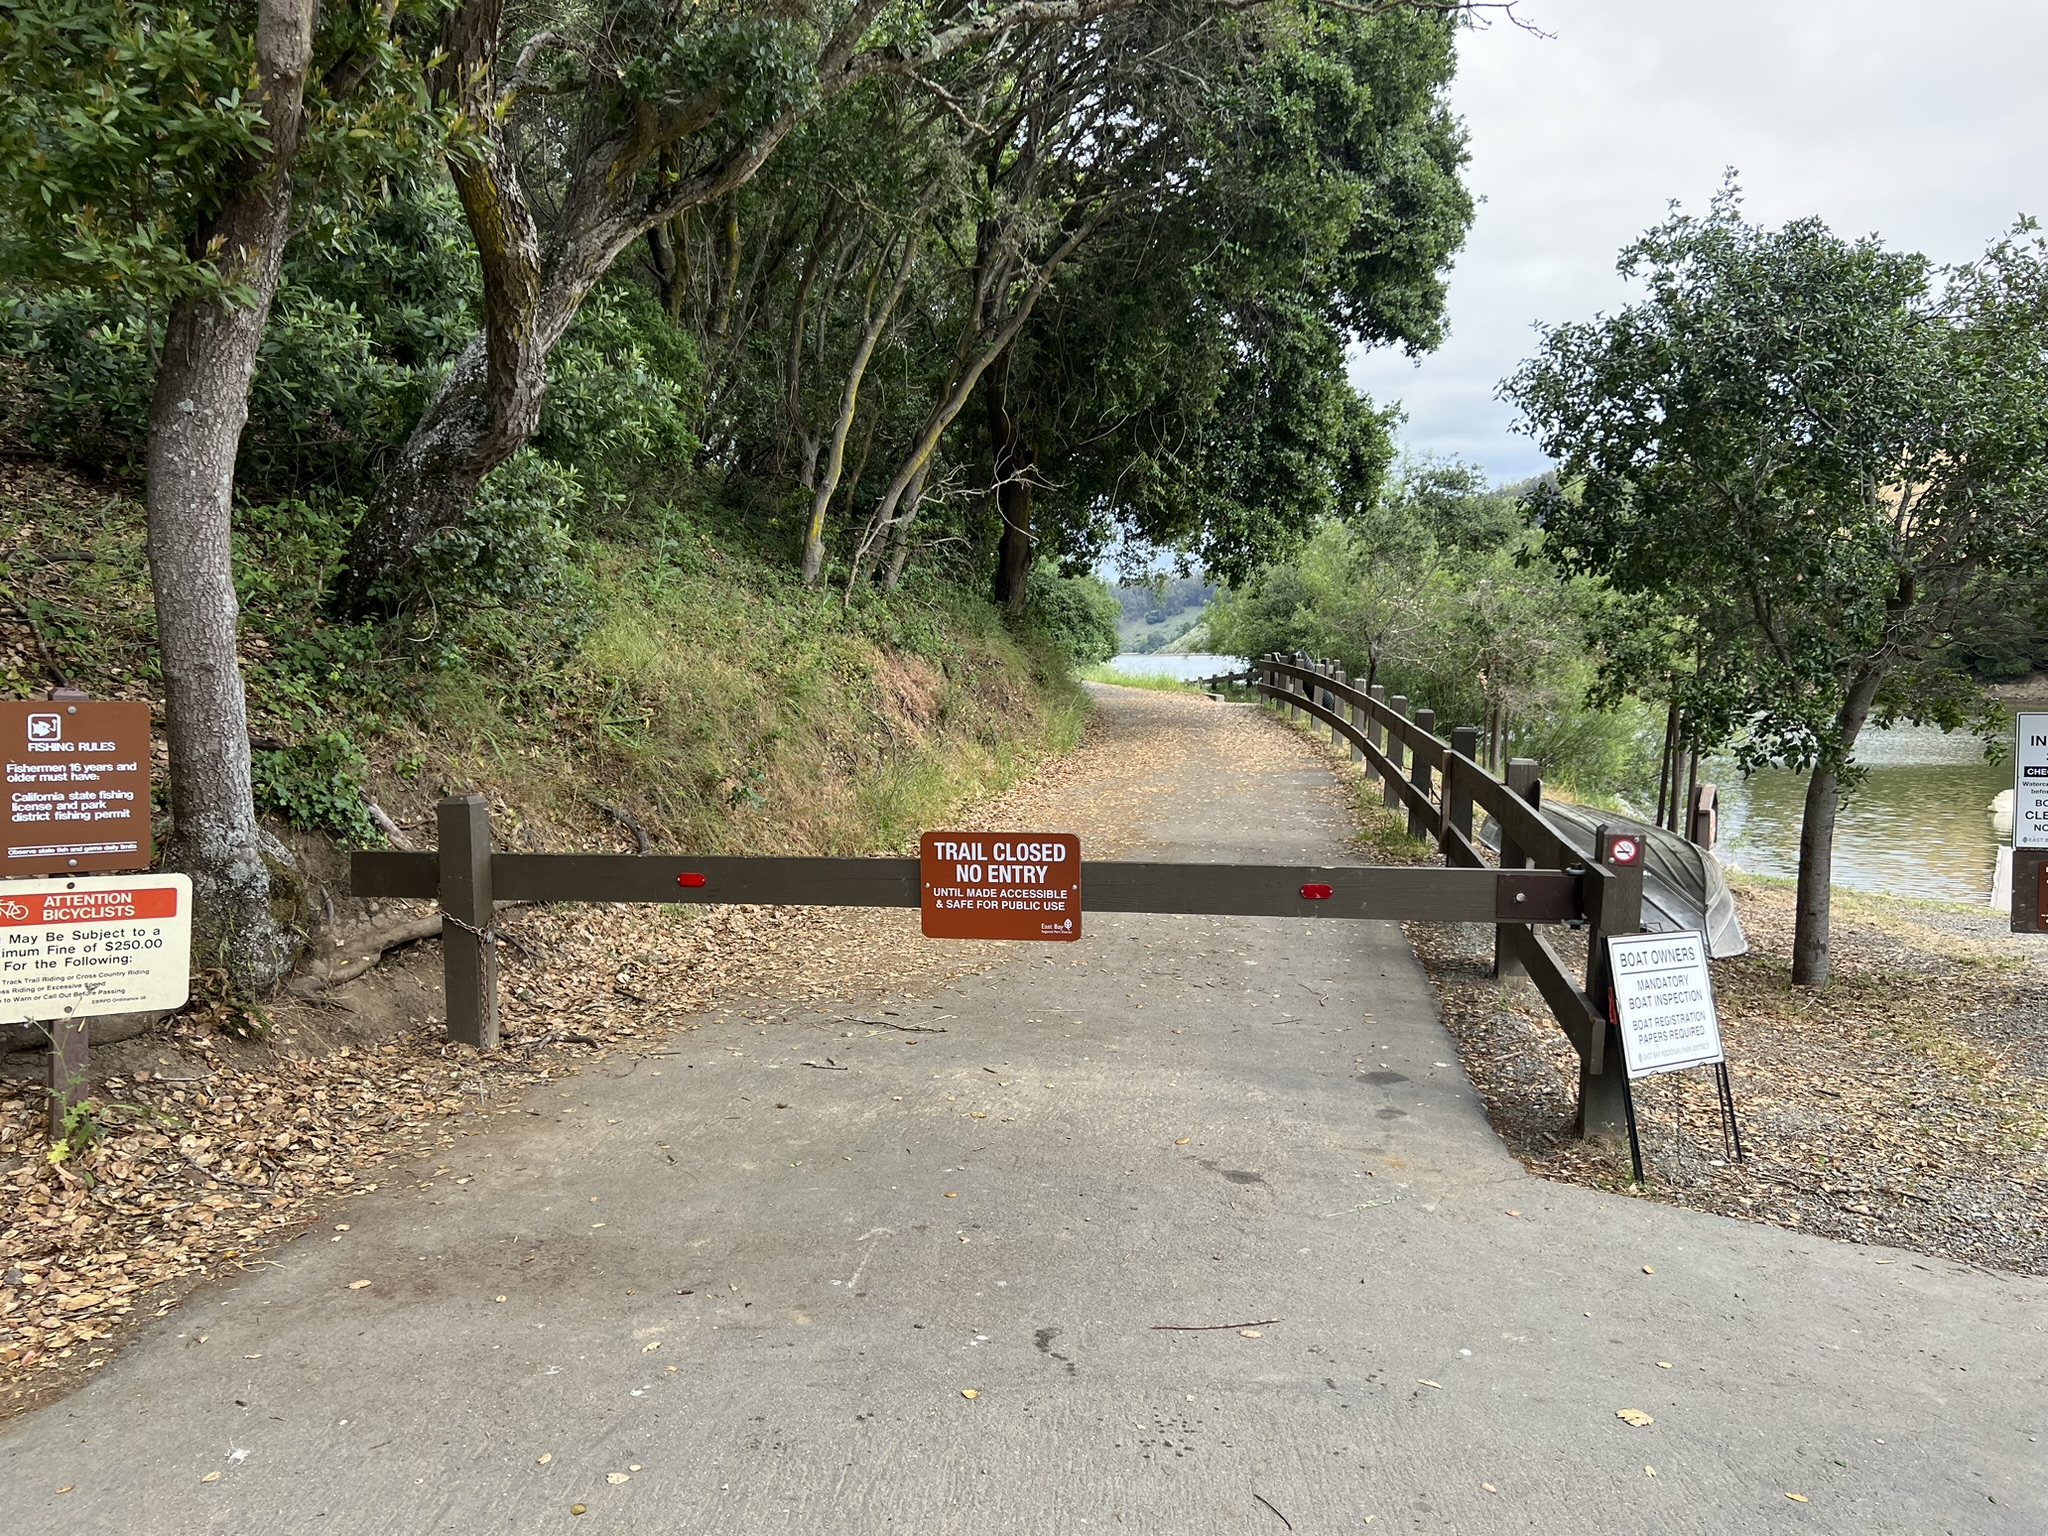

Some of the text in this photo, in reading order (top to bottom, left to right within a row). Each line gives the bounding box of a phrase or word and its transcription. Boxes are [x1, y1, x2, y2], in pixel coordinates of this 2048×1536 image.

[28, 742, 116, 752] FISHING RULES
[6, 762, 137, 774] Fishermen 16 years and
[7, 771, 100, 783] older must have:
[12, 790, 134, 803] California state fishing
[12, 801, 107, 812] license and park
[12, 809, 131, 822] district fishing permit
[934, 841, 1066, 862] TRAIL CLOSED
[956, 864, 1048, 884] NO ENTRY
[43, 893, 132, 908] ATTENTION
[933, 887, 1068, 900] UNTIL MADE ACCESSIBLE
[43, 905, 135, 921] BICYCLISTS
[936, 900, 1066, 911] & SAFE FOR PUBLIC USE
[9, 928, 161, 946] May Be Subject to a
[47, 945, 76, 955] Fine
[83, 943, 98, 953] of
[4, 955, 133, 972] For the Following:
[1620, 947, 1695, 968] BOAT OWNERS
[42, 975, 65, 983] Riding
[98, 971, 126, 979] Country
[1637, 974, 1689, 991] MANDATORY
[46, 983, 82, 991] Excessive
[13, 995, 32, 1003] Warn
[98, 988, 126, 996] Passing
[1629, 990, 1702, 1010] BOAT INSPECTION
[1632, 1011, 1706, 1031] BOAT REGISTRATION
[1638, 1026, 1705, 1045] PAPERS REQUIRED
